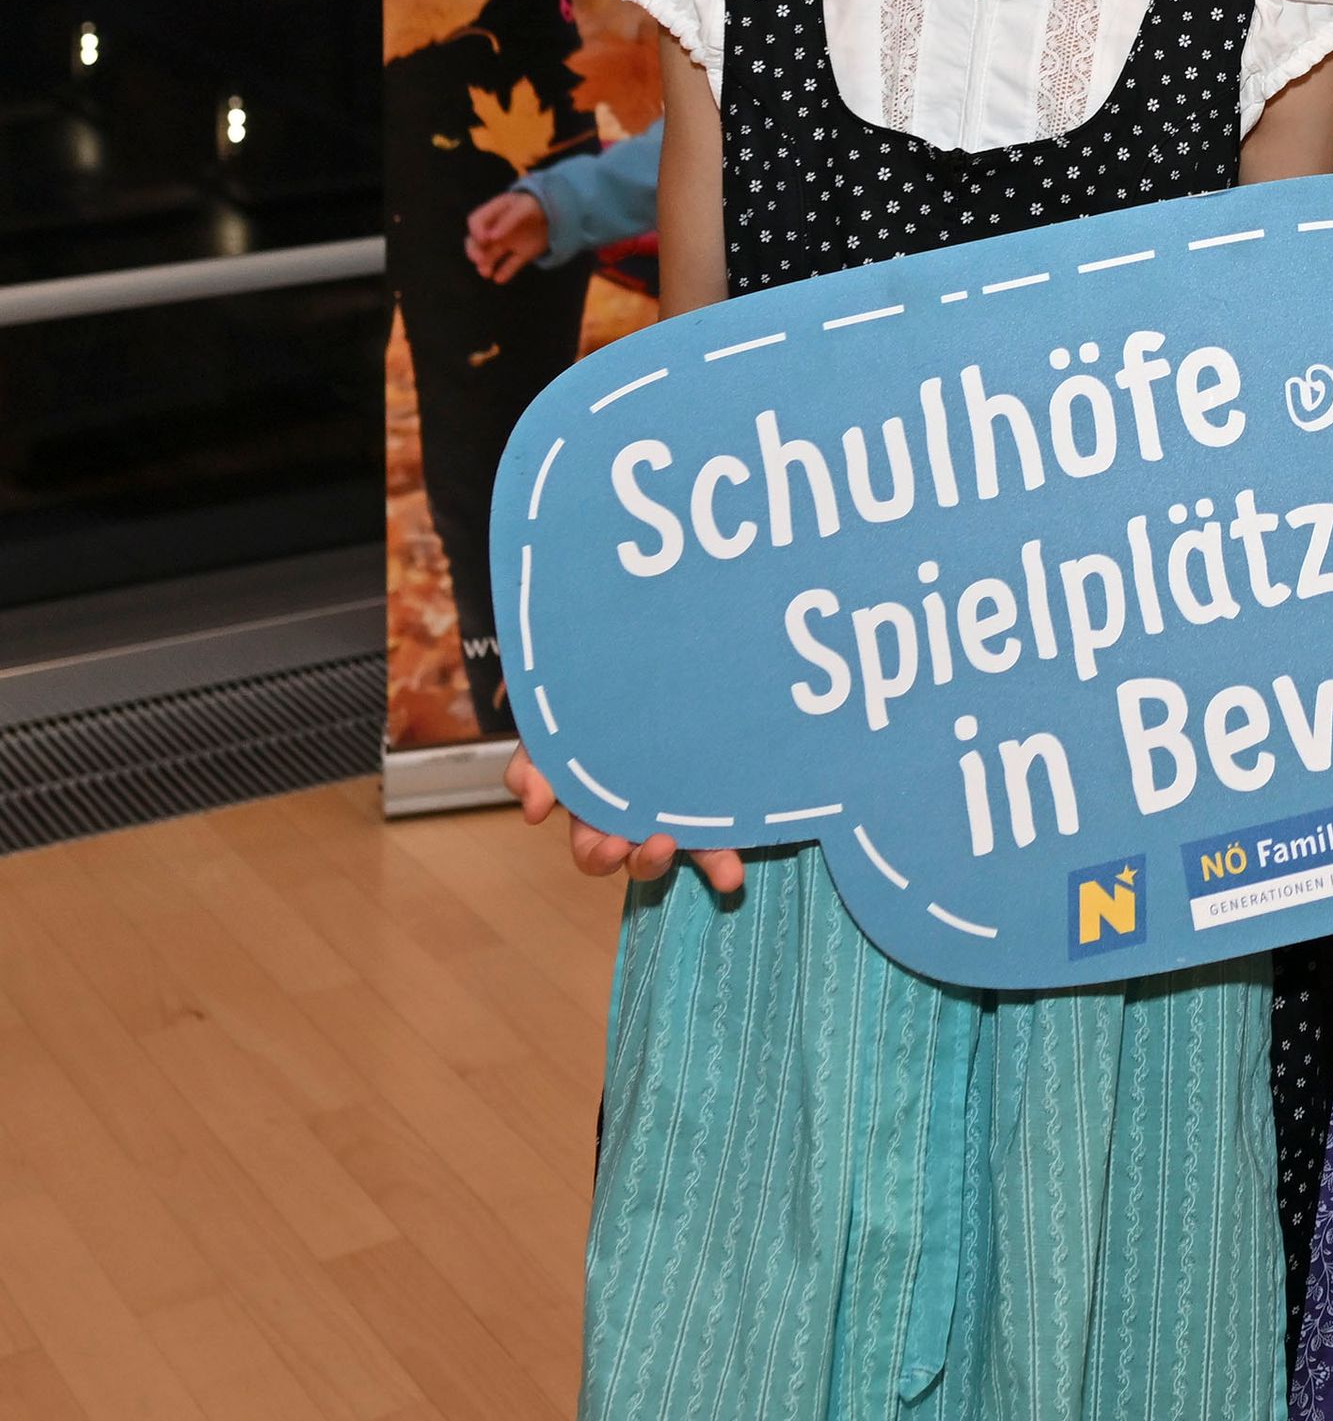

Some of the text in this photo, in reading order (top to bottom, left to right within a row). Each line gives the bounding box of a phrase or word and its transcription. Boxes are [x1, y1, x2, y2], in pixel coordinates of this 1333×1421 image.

[610, 329, 1247, 577] Schulhöfe
[954, 714, 1079, 857] in
[1200, 842, 1248, 882] NÖ
[1079, 879, 1136, 945] N
[1208, 877, 1325, 916] GENERATIONEN
